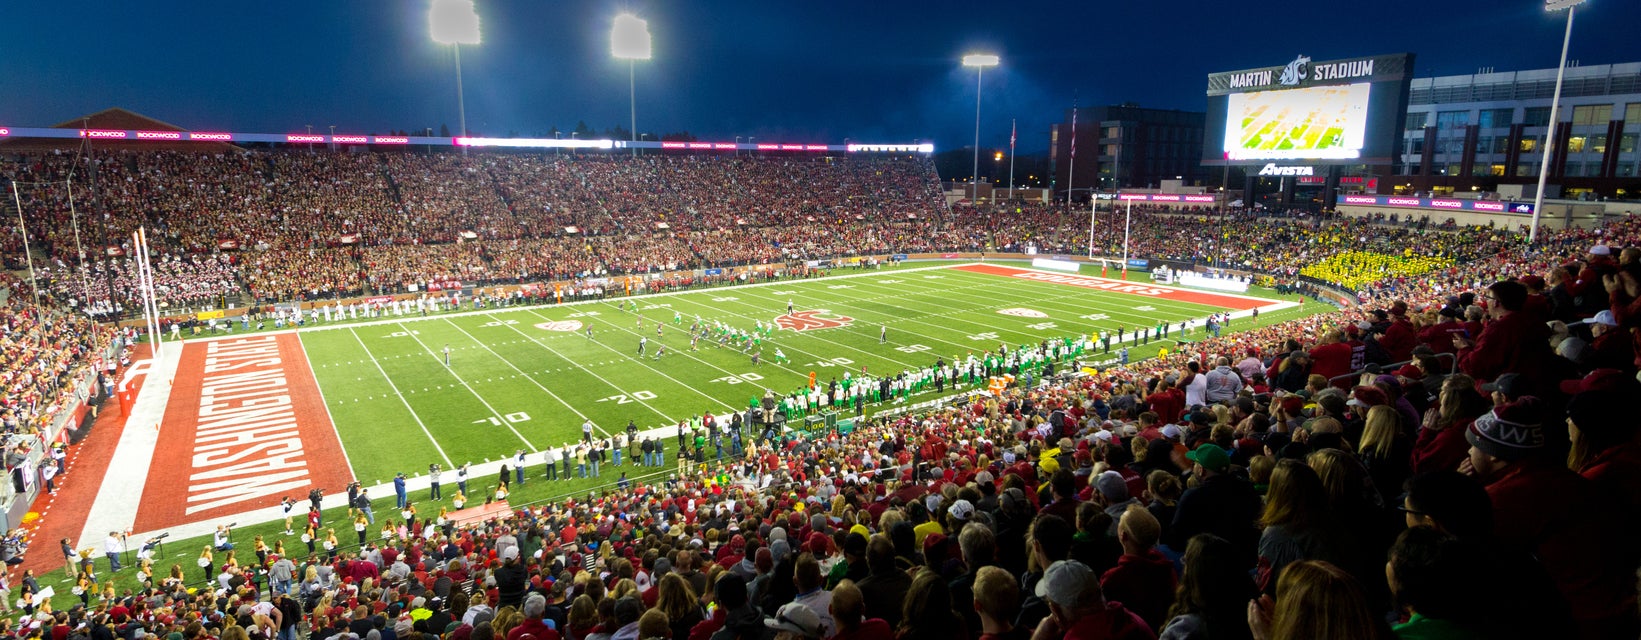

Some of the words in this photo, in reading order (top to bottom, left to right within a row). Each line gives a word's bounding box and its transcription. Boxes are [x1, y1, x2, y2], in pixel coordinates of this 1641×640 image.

[1229, 70, 1272, 88] MARTIN
[1314, 60, 1374, 81] STADIUM
[137, 131, 180, 139] ROCKWOOD
[190, 132, 232, 140] ROCKWOOD
[1012, 271, 1175, 296] COUGARS
[204, 335, 282, 374] STATE
[719, 372, 765, 385] 30
[611, 390, 659, 405] 20
[485, 411, 532, 426] 10
[185, 368, 312, 515] WASHINGTON
